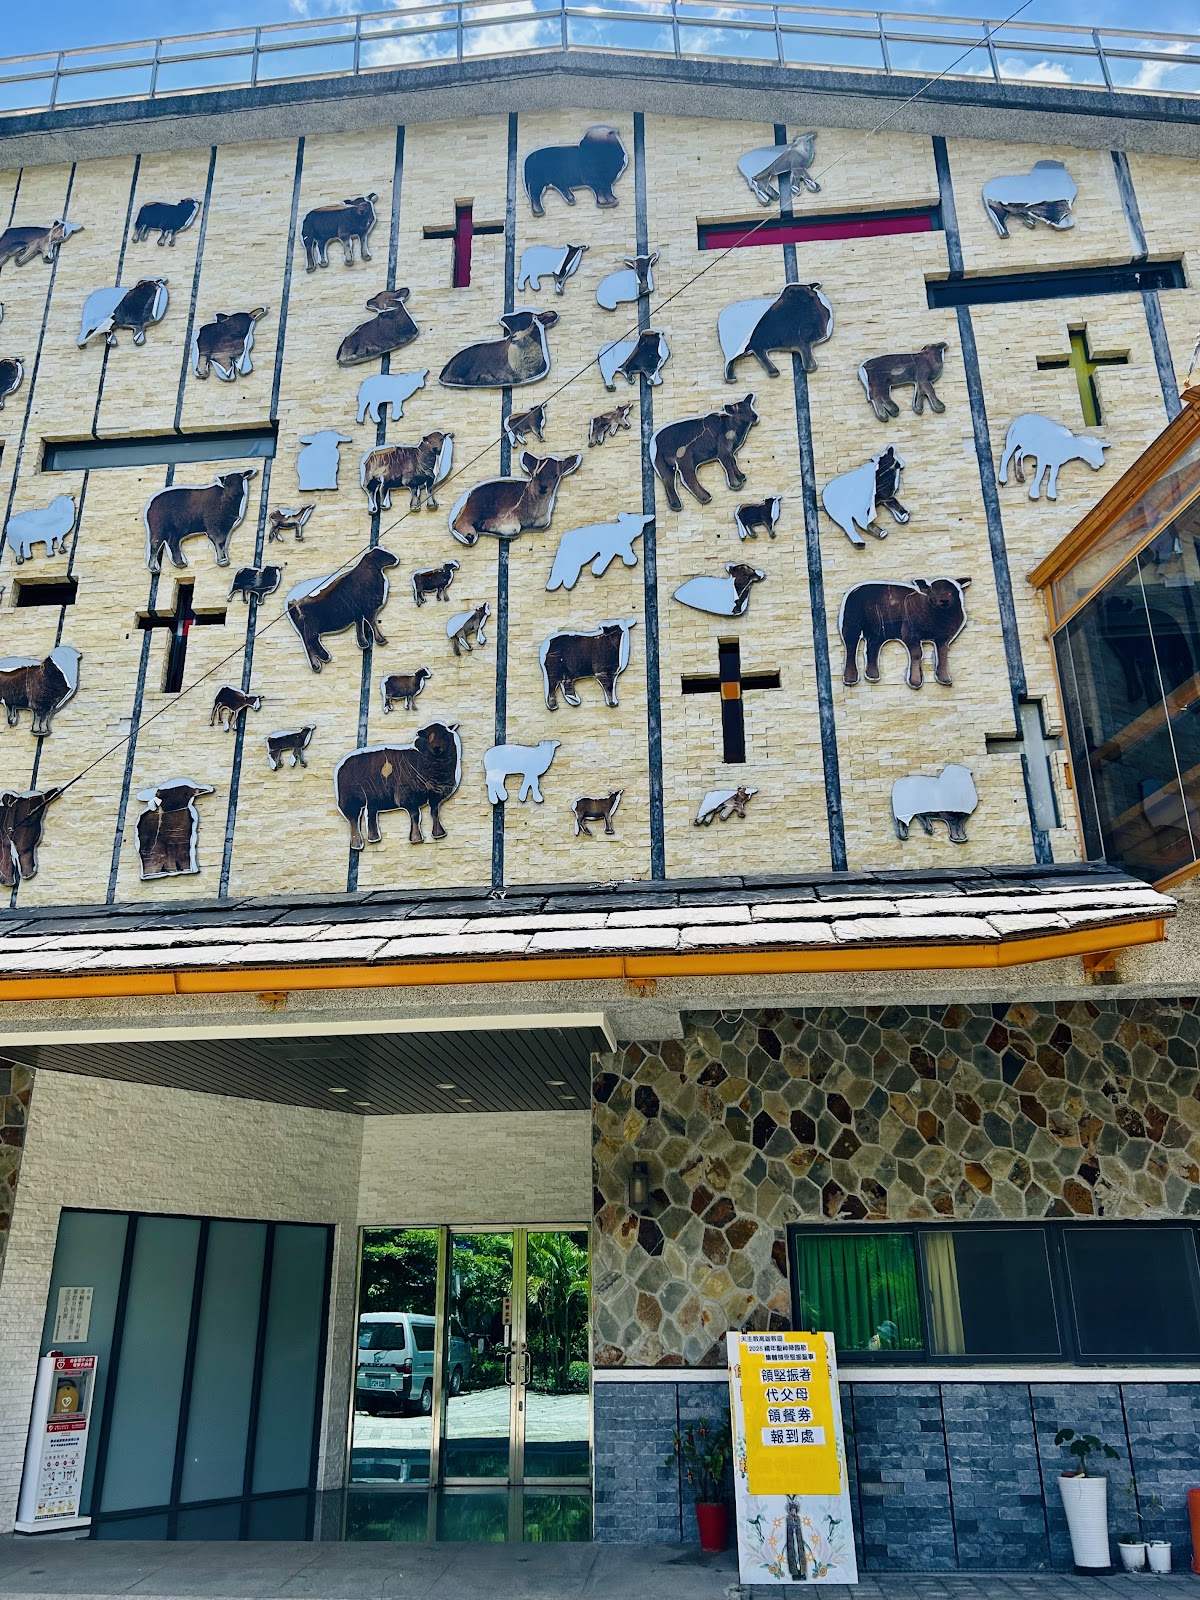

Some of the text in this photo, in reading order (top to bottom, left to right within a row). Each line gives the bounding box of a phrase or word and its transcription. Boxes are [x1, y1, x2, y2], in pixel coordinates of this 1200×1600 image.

[761, 1368, 811, 1382] 領堅振者
[766, 1388, 808, 1402] 代父母
[768, 1408, 811, 1423] 領餐券
[770, 1429, 815, 1444] 報到處
